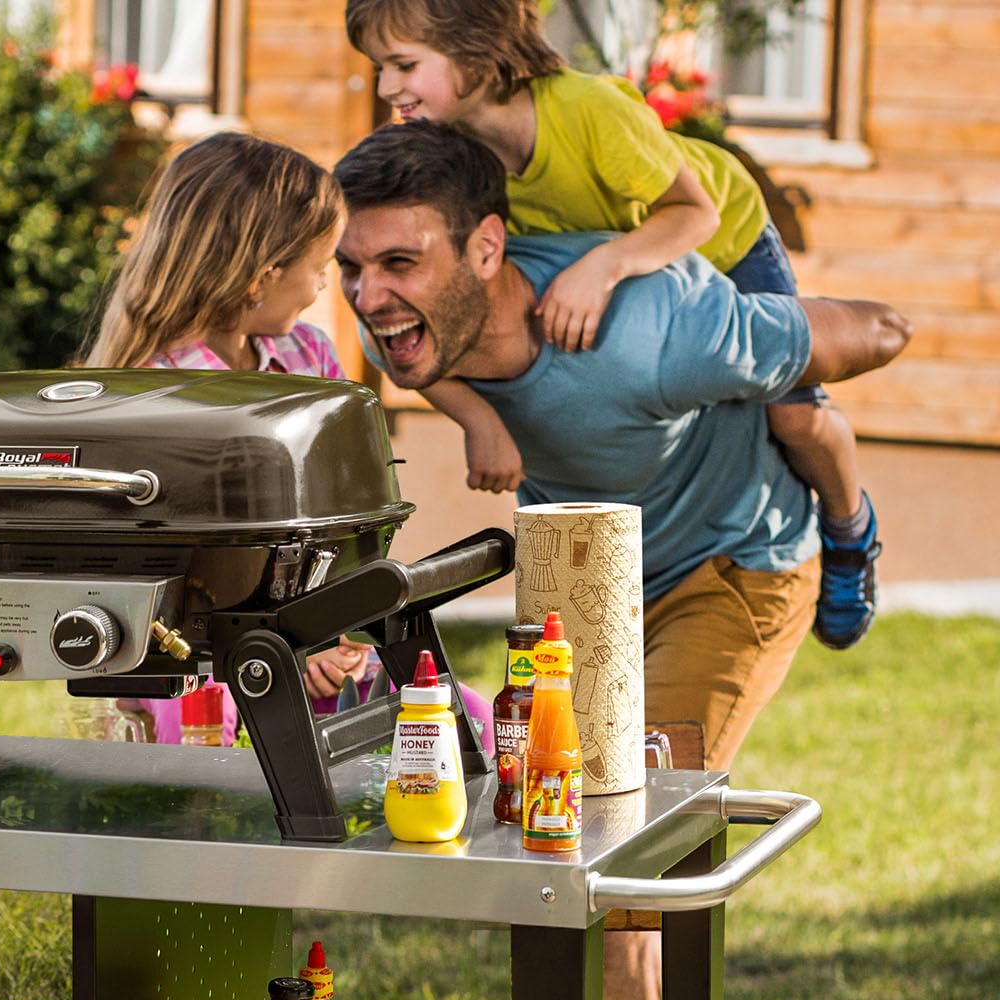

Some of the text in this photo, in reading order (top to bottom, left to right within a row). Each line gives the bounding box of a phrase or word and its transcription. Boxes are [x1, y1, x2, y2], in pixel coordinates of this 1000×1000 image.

[496, 723, 529, 739] BARBE
[401, 740, 435, 750] HONEY
[498, 737, 518, 748] SAUCE
